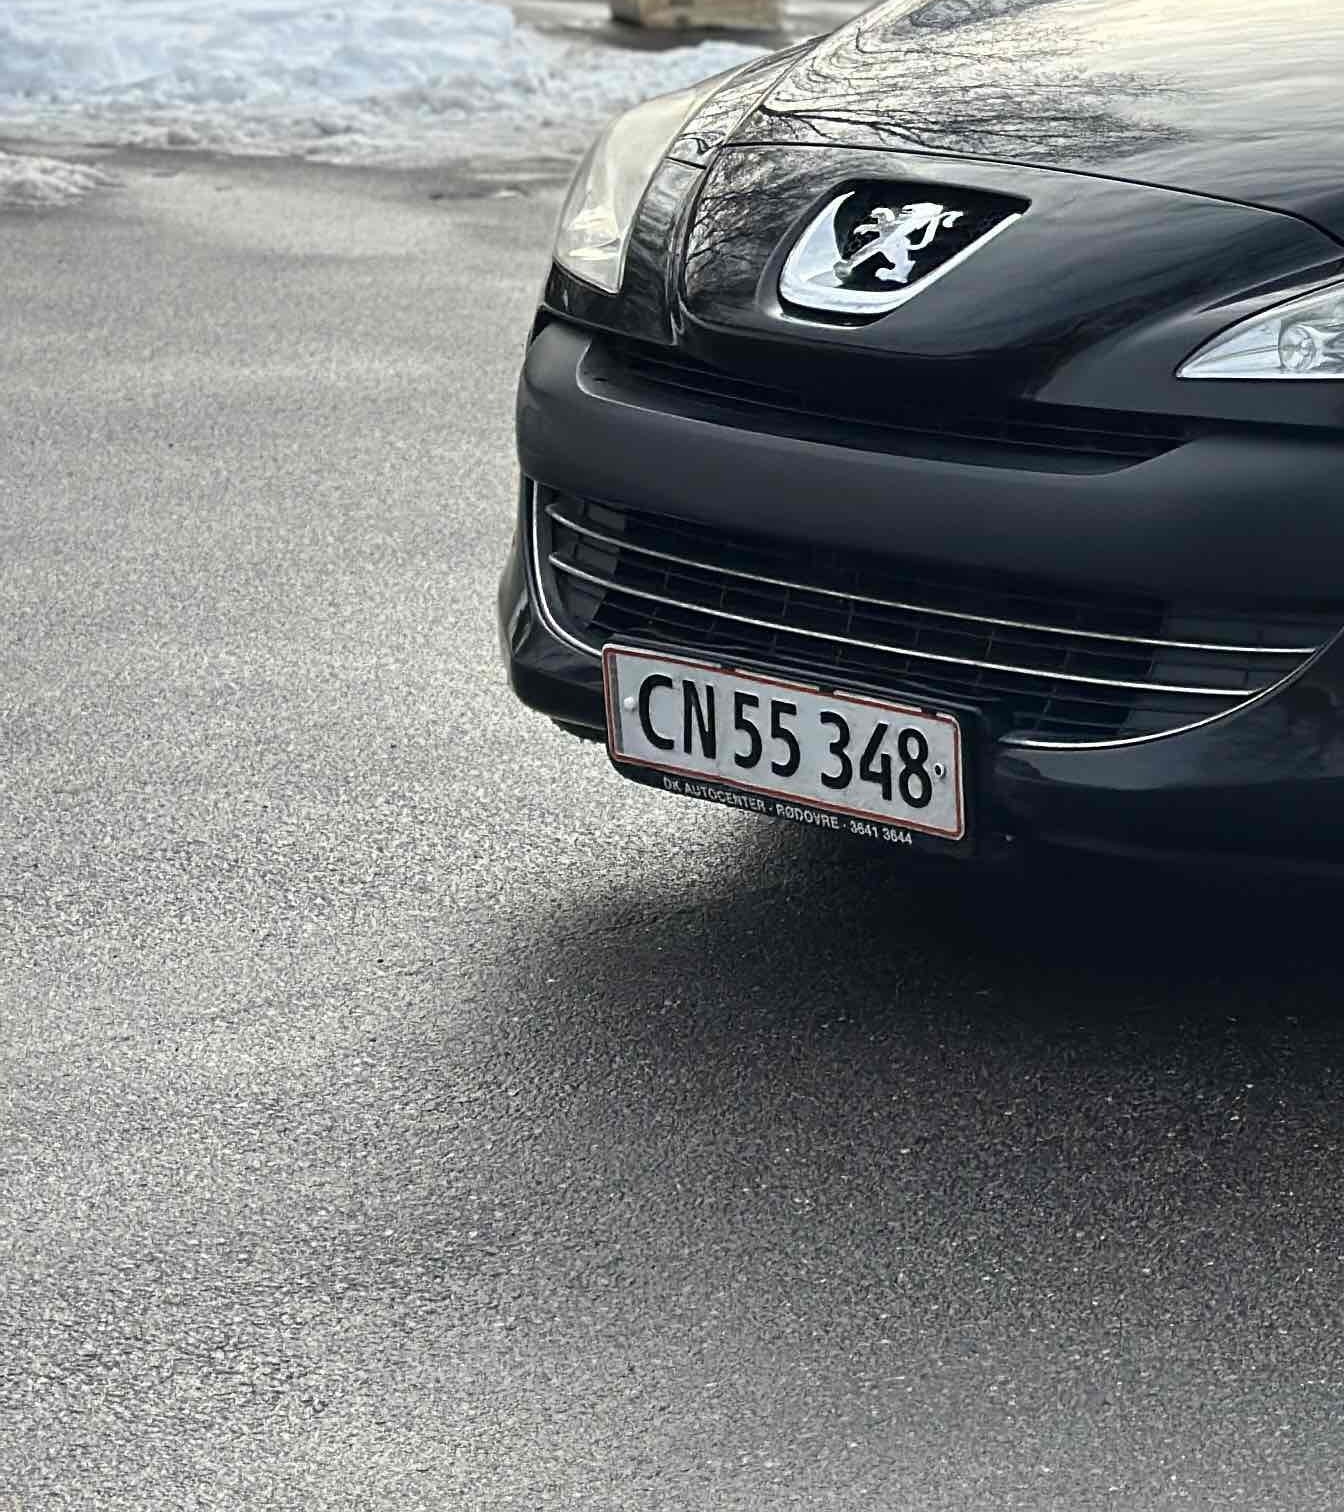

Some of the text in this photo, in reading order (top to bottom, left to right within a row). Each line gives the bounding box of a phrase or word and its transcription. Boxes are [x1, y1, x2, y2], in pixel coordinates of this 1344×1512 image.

[638, 674, 932, 809] CN 55 348
[663, 776, 680, 790] DK
[684, 782, 766, 812] AUTOCENTER
[776, 804, 839, 829] RØDOVRE
